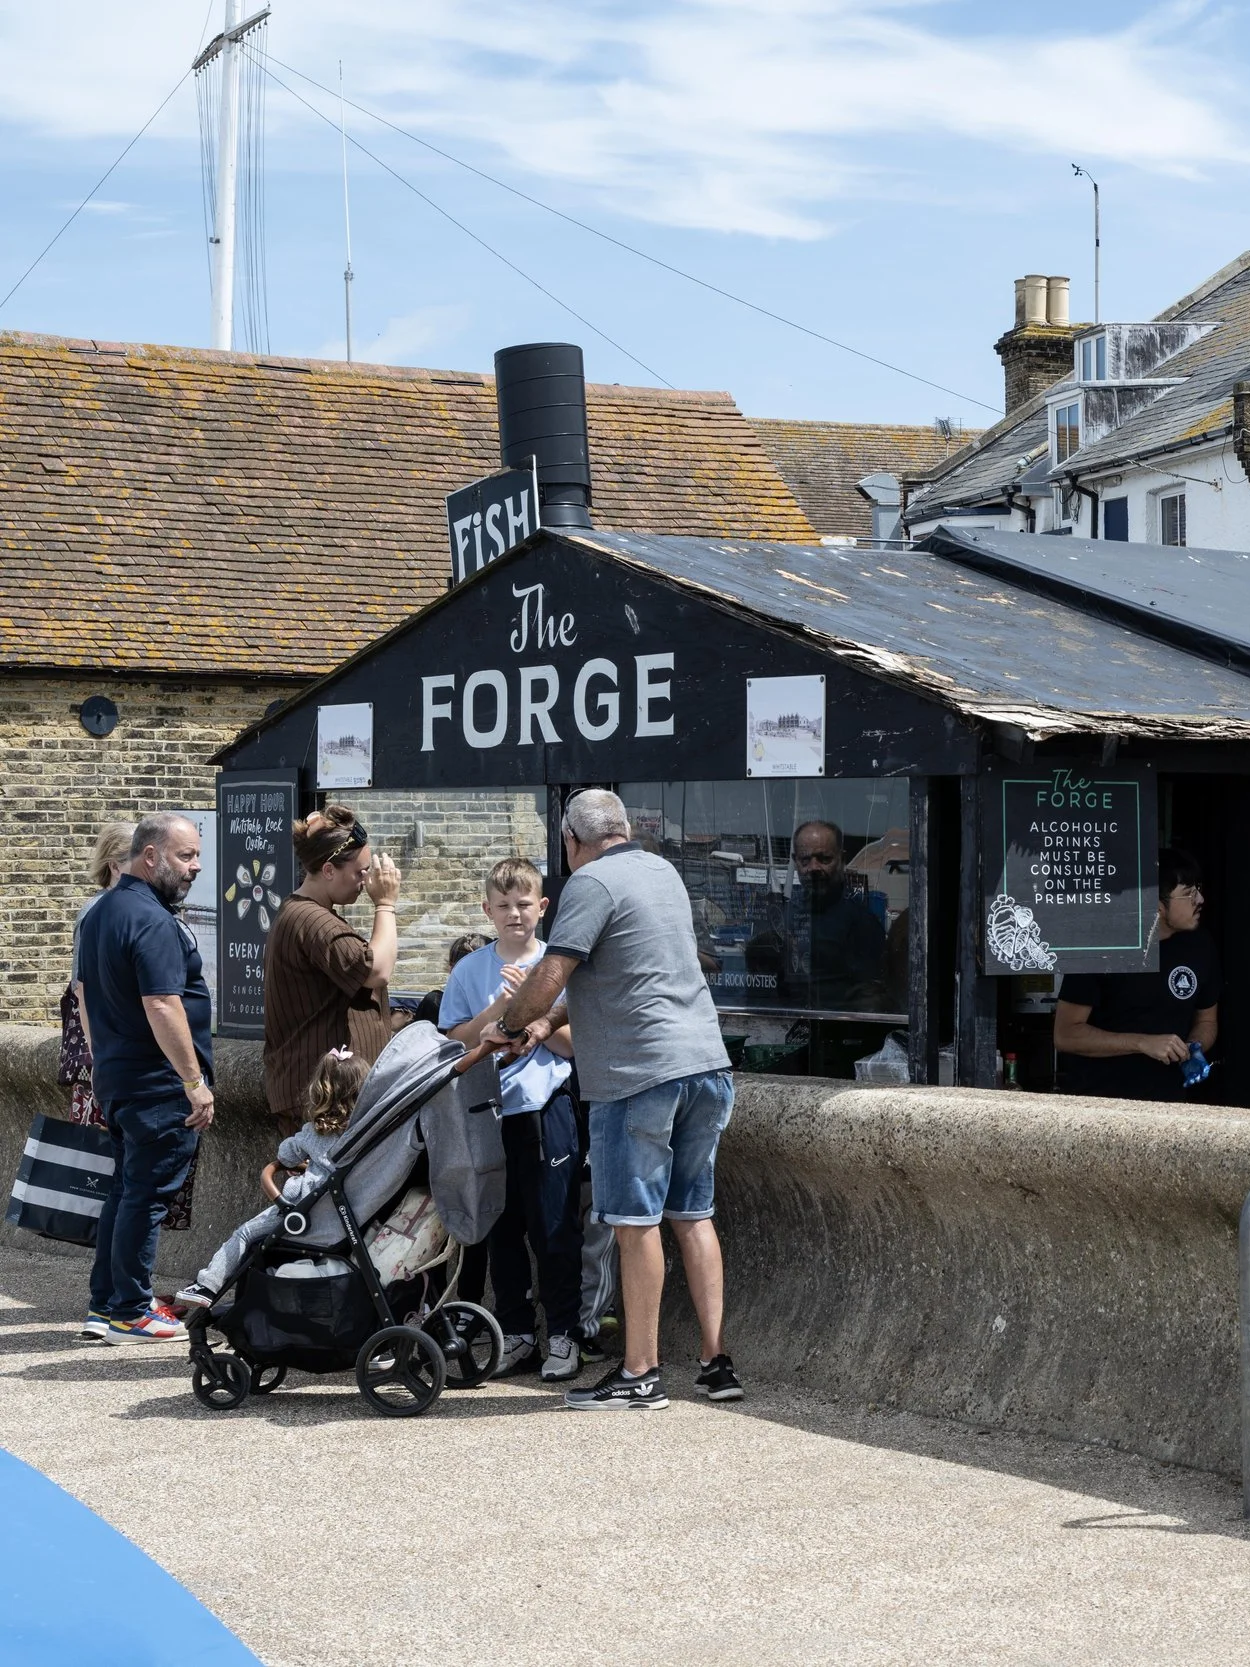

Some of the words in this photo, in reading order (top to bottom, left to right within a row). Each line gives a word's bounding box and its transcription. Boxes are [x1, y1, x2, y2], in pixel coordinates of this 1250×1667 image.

[510, 583, 578, 653] The
[421, 652, 675, 752] FORGE
[1053, 769, 1092, 791] The
[227, 794, 256, 813] HAPPY
[260, 792, 285, 812] HOUR
[1037, 791, 1113, 809] FORGE
[230, 817, 262, 835] Whitstable
[265, 817, 284, 834] Rock
[1030, 821, 1118, 833] ALCOHOLIC
[245, 836, 268, 851] Oyster
[1044, 836, 1101, 848] DRINKS
[1040, 850, 1080, 862] MUST
[1087, 850, 1106, 862] BE
[1030, 863, 1116, 876] CONSUMED
[1045, 878, 1066, 890] ON
[1073, 878, 1101, 890] THE
[1035, 892, 1112, 905] PREMISES
[229, 941, 260, 960] EVERY
[703, 973, 723, 987] ABLE
[725, 973, 745, 988] ROCK
[746, 973, 777, 989] OYSTERS
[240, 1003, 265, 1015] DOZEN
[612, 1389, 631, 1397] adidas
